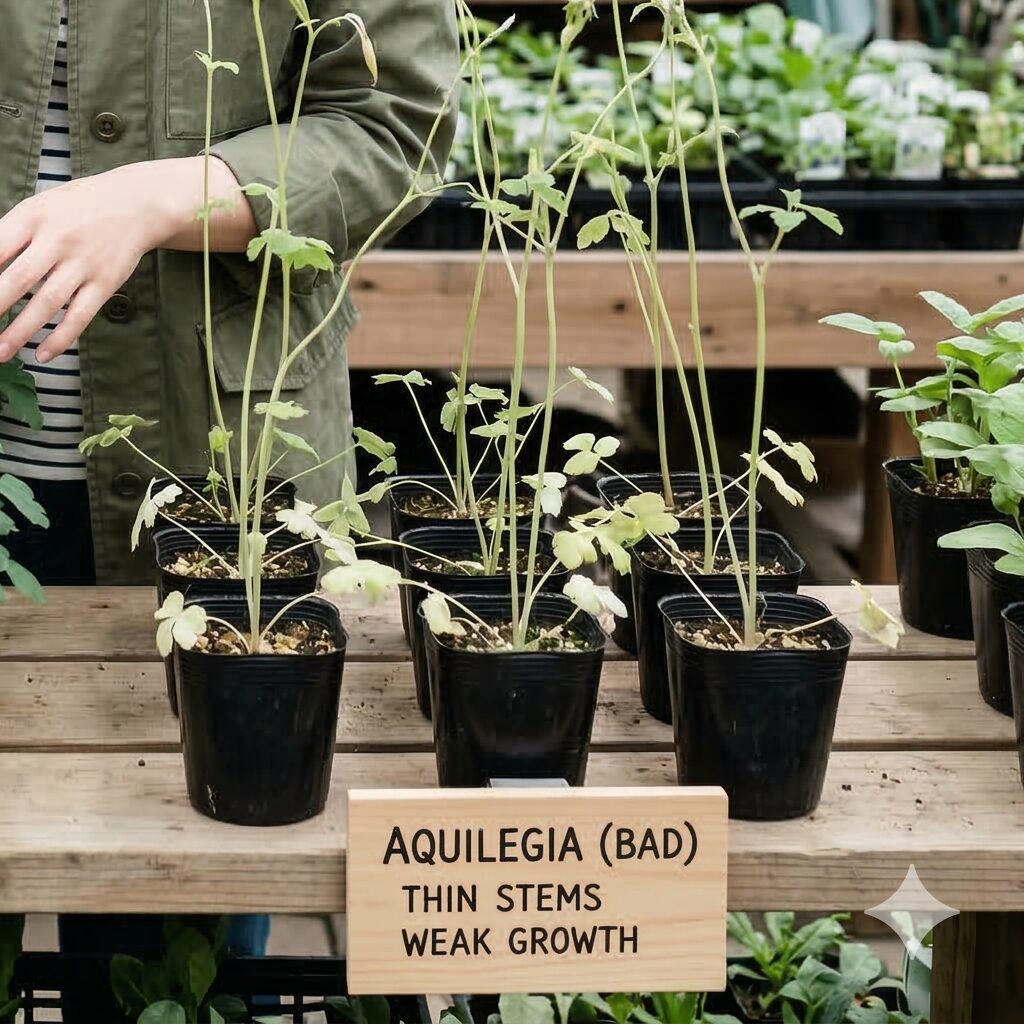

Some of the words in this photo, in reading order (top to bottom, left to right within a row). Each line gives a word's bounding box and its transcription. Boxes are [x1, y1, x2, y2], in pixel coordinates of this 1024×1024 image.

[383, 826, 583, 865] AQUILEGIA
[600, 821, 697, 867] (BAD)
[402, 884, 477, 913] THIN
[496, 883, 602, 912] STEMS
[402, 927, 491, 957] WEAK
[509, 925, 638, 955] GROWTH
